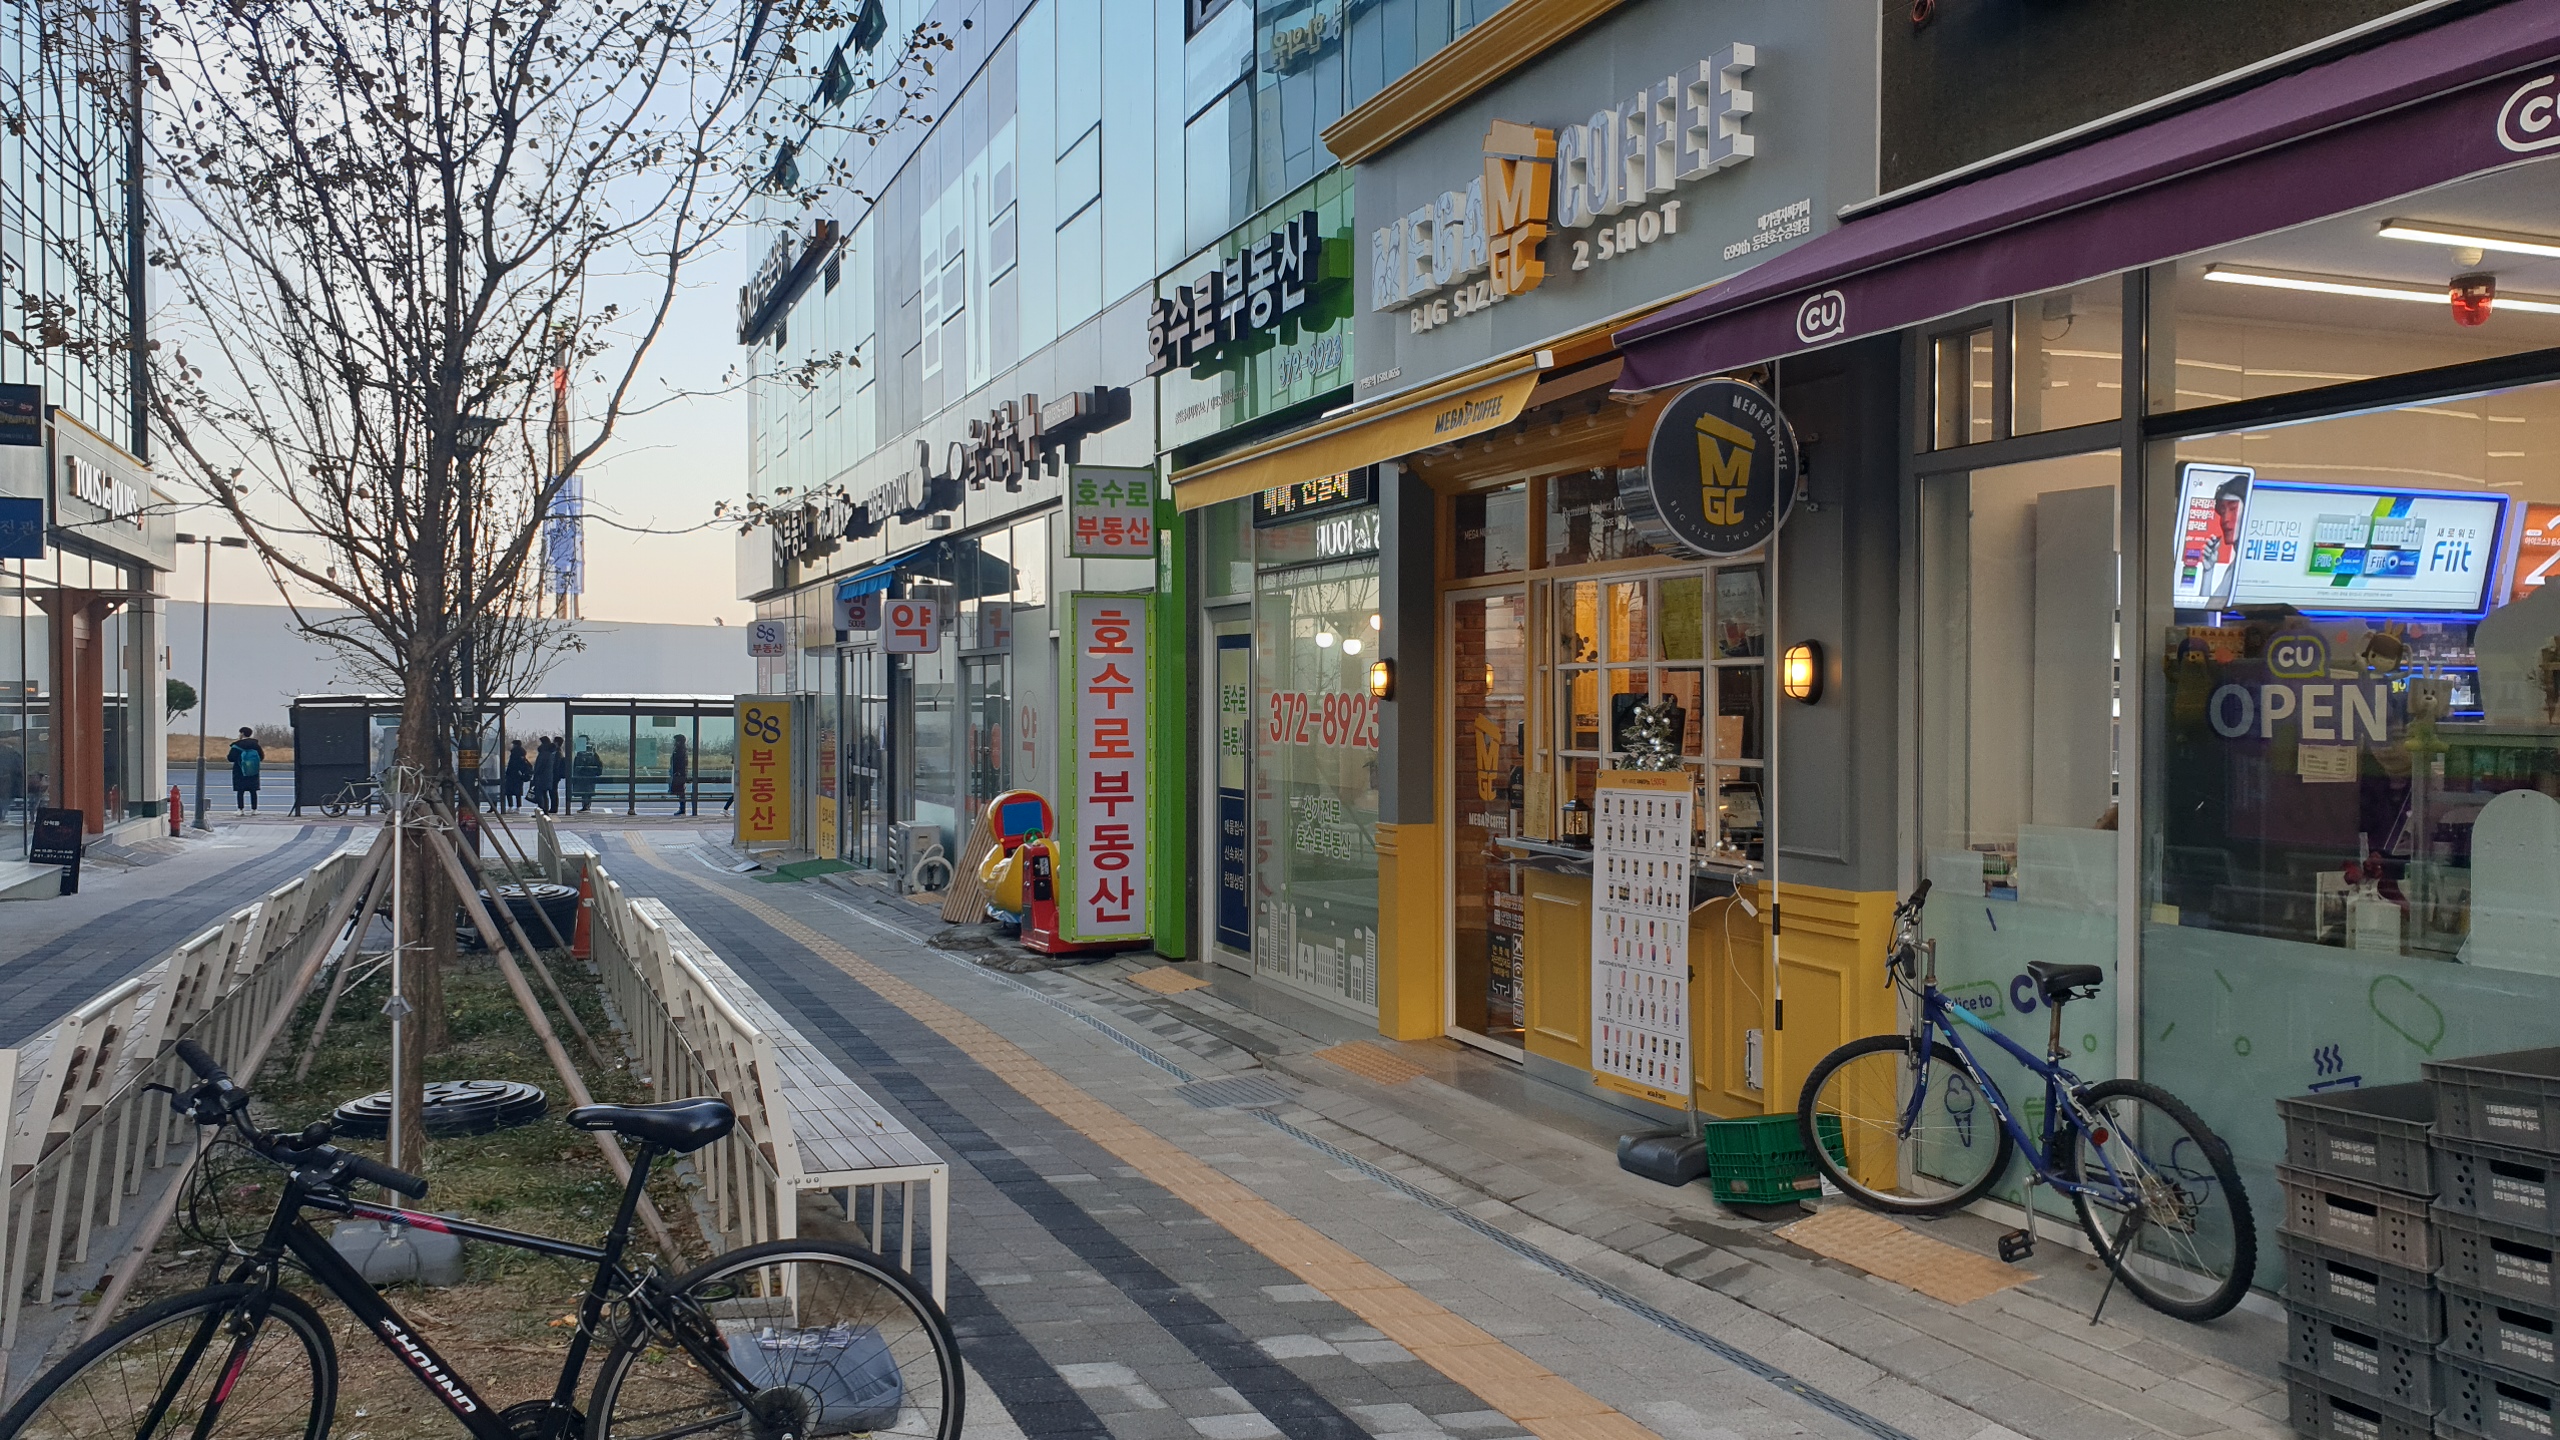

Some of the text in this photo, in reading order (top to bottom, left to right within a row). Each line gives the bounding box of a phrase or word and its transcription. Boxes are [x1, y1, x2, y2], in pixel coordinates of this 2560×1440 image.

[2520, 93, 2560, 133] C
[1372, 175, 1489, 312] MEGA
[1557, 42, 1755, 228] COFFEE
[1724, 217, 1810, 261] 699th 동탄호수공원점
[1411, 296, 1448, 334] BIG
[1572, 240, 1589, 271] 2
[1597, 201, 1681, 260] SHOT
[1146, 211, 1318, 378] 호수로부동산
[1806, 298, 1839, 331] CU
[1434, 396, 1503, 435] MEGA COFFEE
[1733, 395, 1763, 419] MEGA
[67, 456, 139, 525] TOUS les JOURS
[1075, 478, 1149, 508] 호수로
[1075, 517, 1151, 548] 부동산
[1670, 499, 1686, 522] BIG
[1690, 524, 1716, 541] SIZE
[1726, 531, 1750, 542] TWO
[2250, 519, 2302, 538] 맛,디자인
[2437, 527, 2476, 539] 새로워진
[2245, 539, 2298, 562] 레벨업
[2370, 555, 2386, 568] Fiit
[2430, 540, 2472, 573] Fiit
[756, 624, 776, 642] 88
[891, 604, 932, 648] 약
[752, 643, 783, 654] 부동산
[2278, 645, 2314, 667] CU
[1222, 685, 1246, 713] 호수로
[2209, 684, 2388, 742] OPEN
[744, 707, 781, 744] 88
[1021, 705, 1037, 769] 약
[1270, 692, 1379, 748] 372-8923
[1222, 726, 1244, 756] 부동산
[1088, 610, 1135, 923] 호수로부동산
[750, 749, 776, 831] 부동산
[1468, 811, 1508, 830] MEGA COFFEE
[1296, 825, 1351, 860] 호수로부동산
[1979, 994, 1992, 1009] to
[396, 1333, 477, 1413] HOUND
